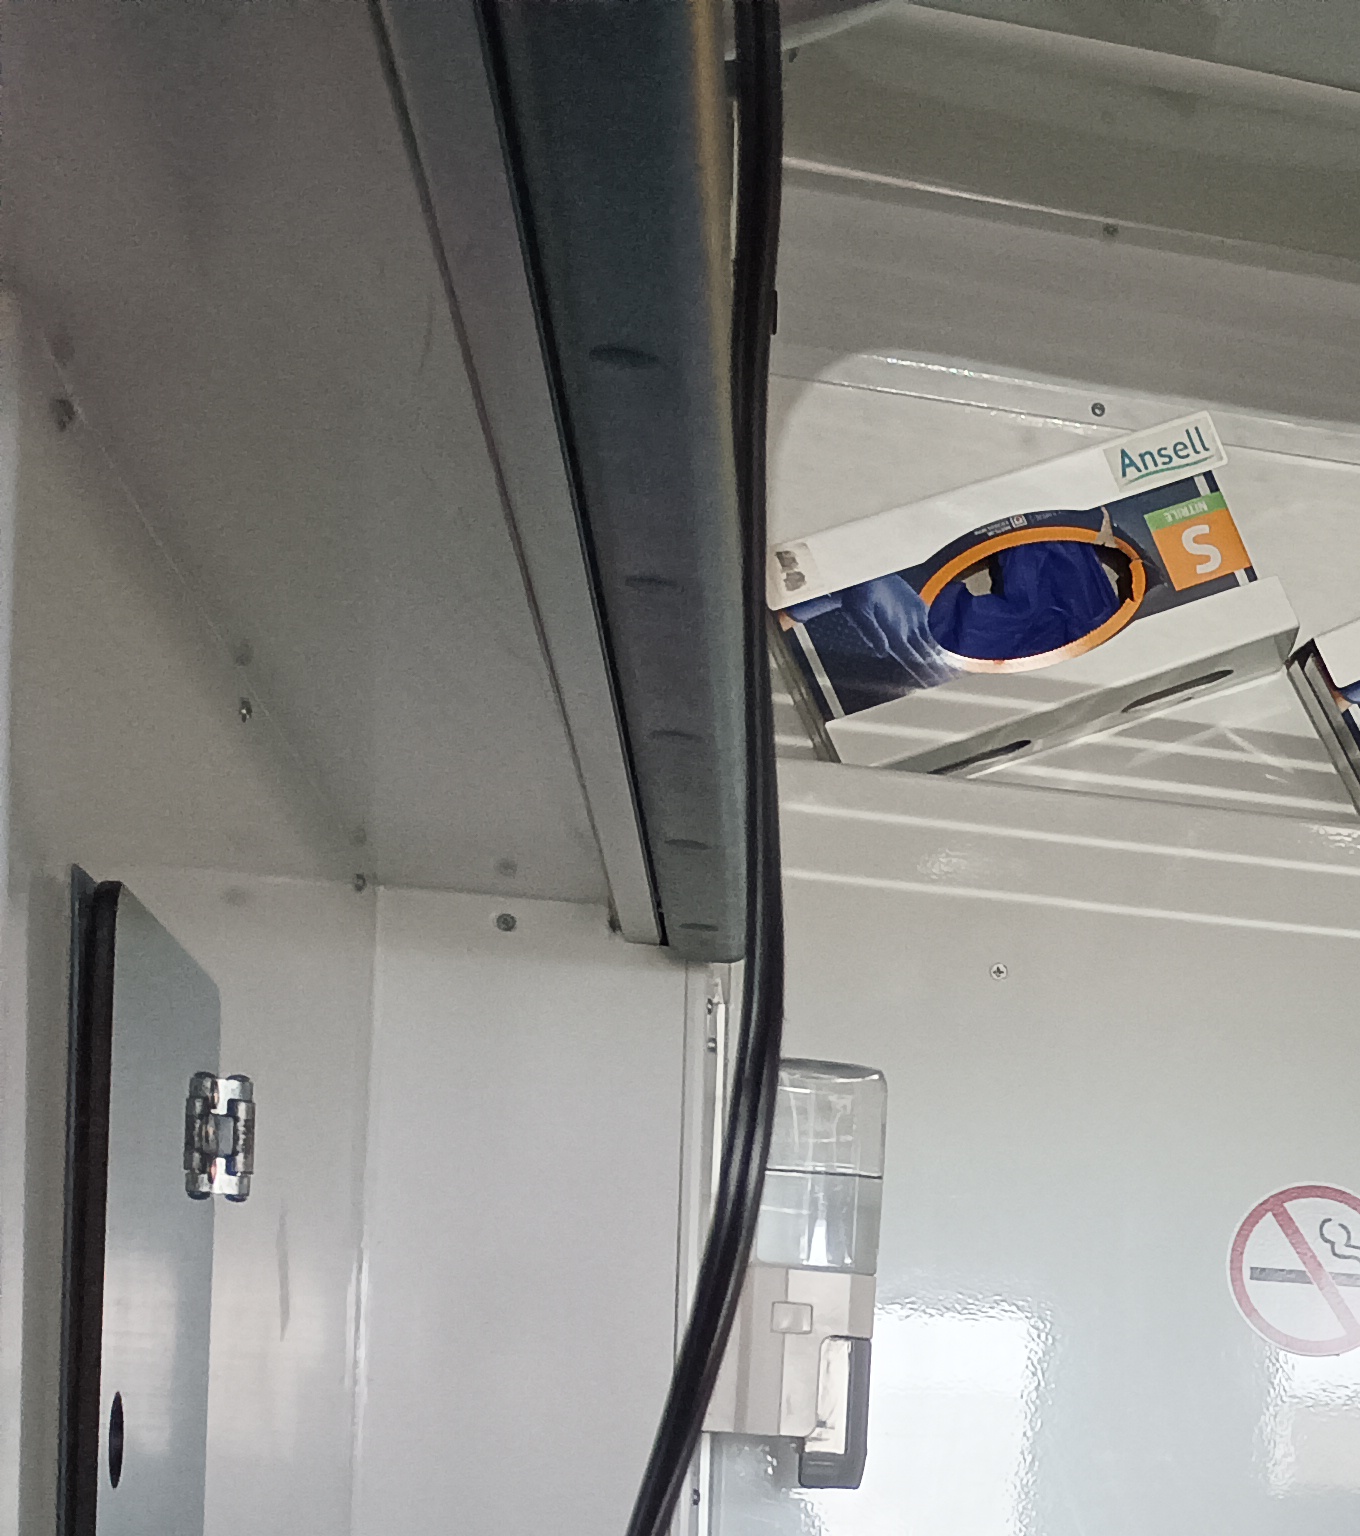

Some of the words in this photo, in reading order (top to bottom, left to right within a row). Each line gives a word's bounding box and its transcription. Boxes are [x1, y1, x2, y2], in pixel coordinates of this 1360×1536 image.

[1119, 424, 1210, 478] Ansell
[1163, 500, 1208, 522] NITRILE
[1180, 525, 1222, 574] S
